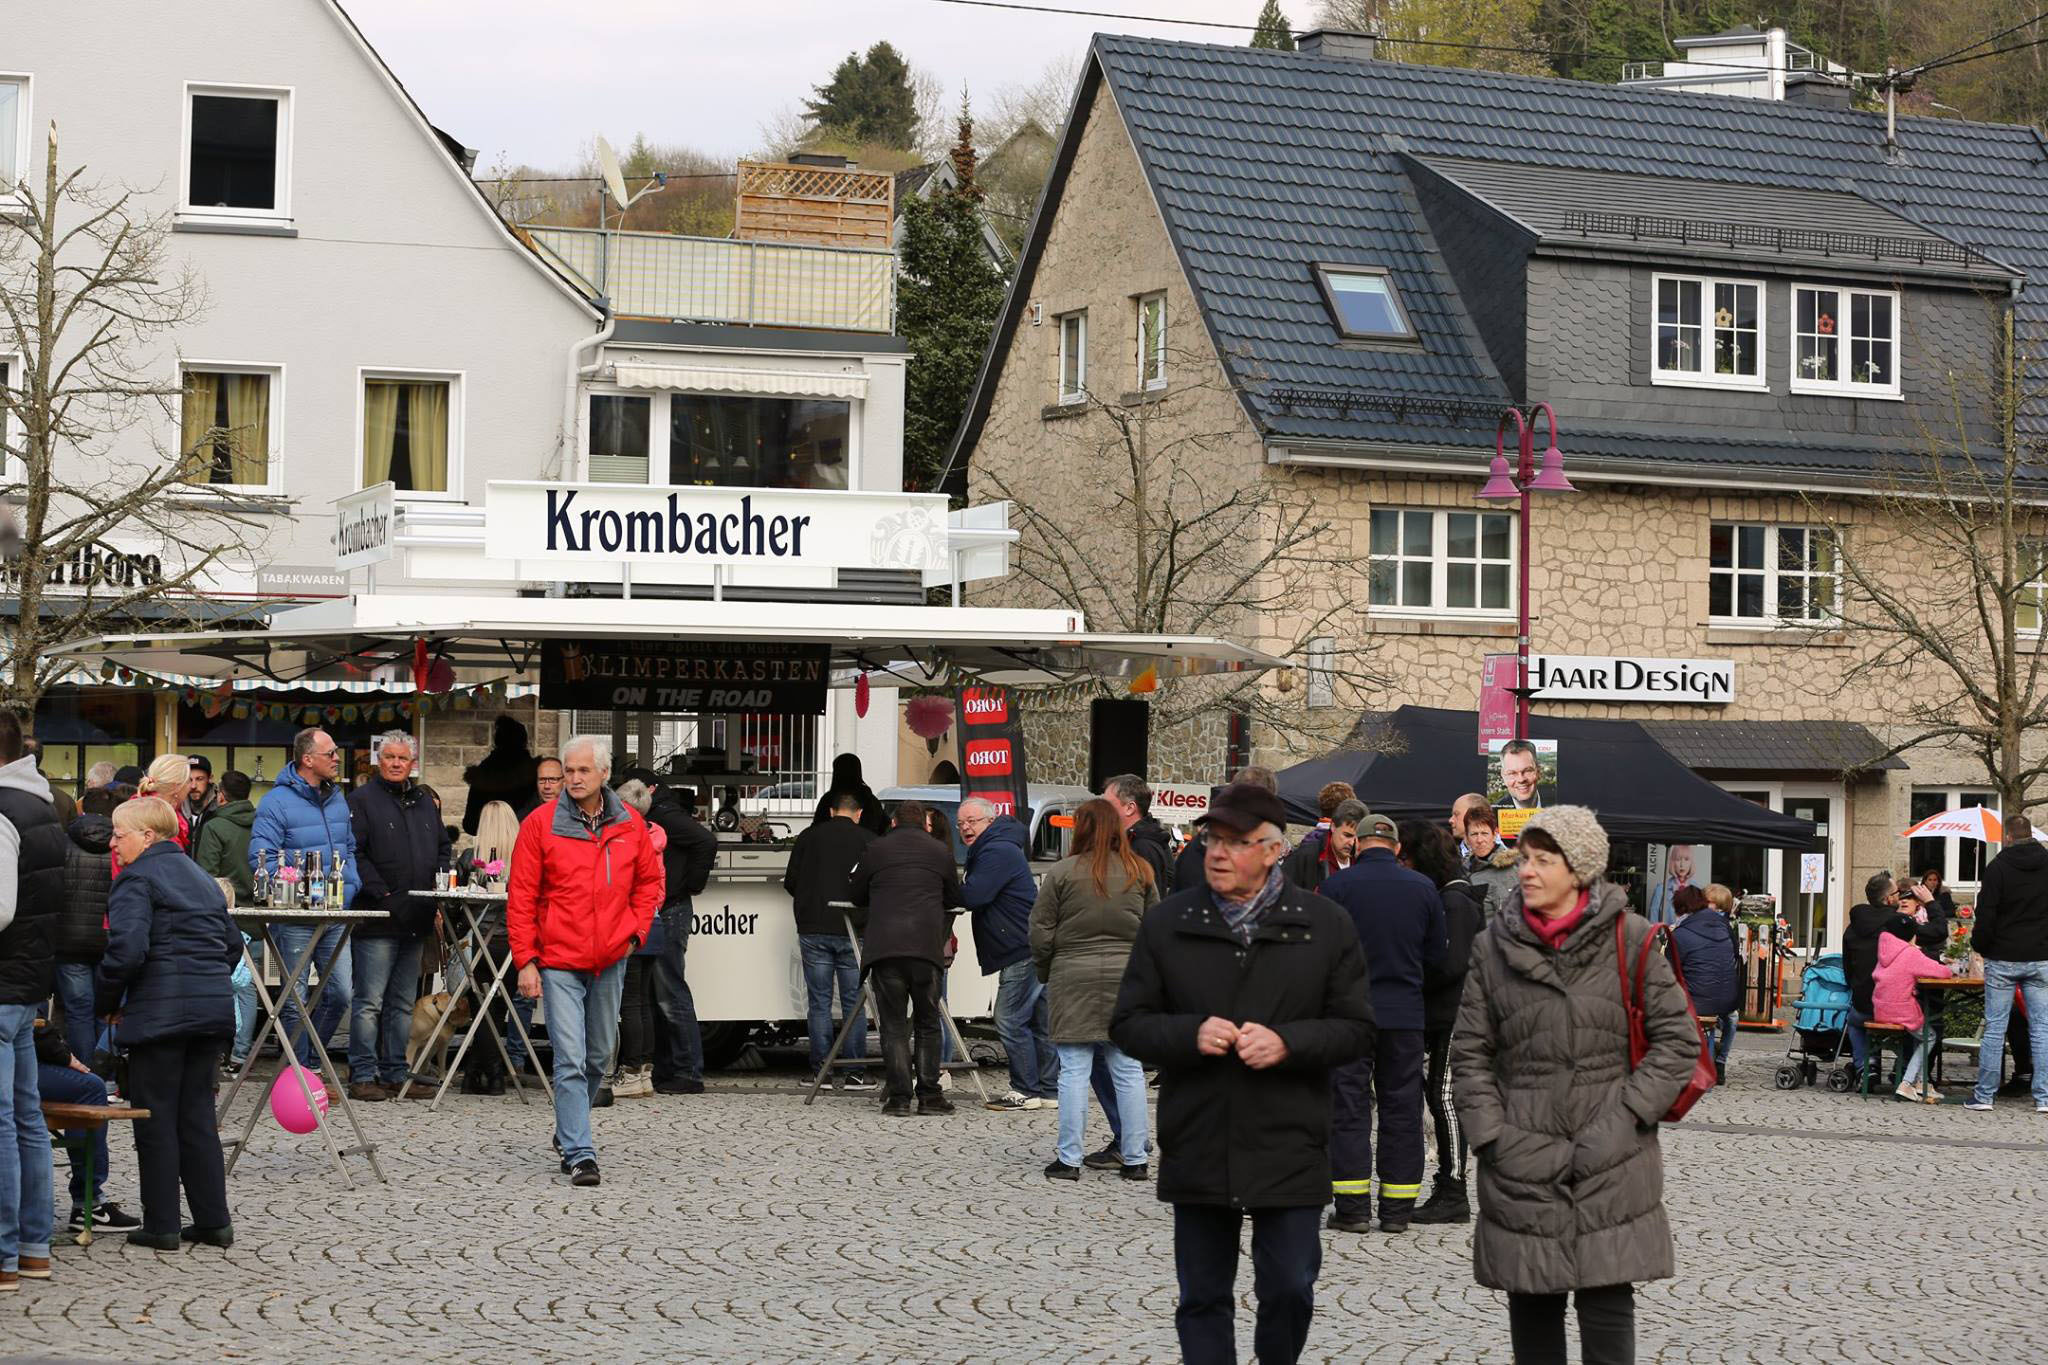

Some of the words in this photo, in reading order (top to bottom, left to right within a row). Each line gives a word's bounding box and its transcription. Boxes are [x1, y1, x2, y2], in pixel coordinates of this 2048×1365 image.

[338, 503, 388, 557] Krombacher
[546, 489, 811, 557] Krombacher
[262, 573, 345, 585] TABAKWAREN
[583, 653, 821, 681] KLIMPERKASTEN
[612, 687, 648, 705] ON
[656, 689, 701, 707] THE
[708, 690, 773, 708] ROAD
[1157, 790, 1207, 808] Klees
[1924, 823, 1972, 832] STIHL
